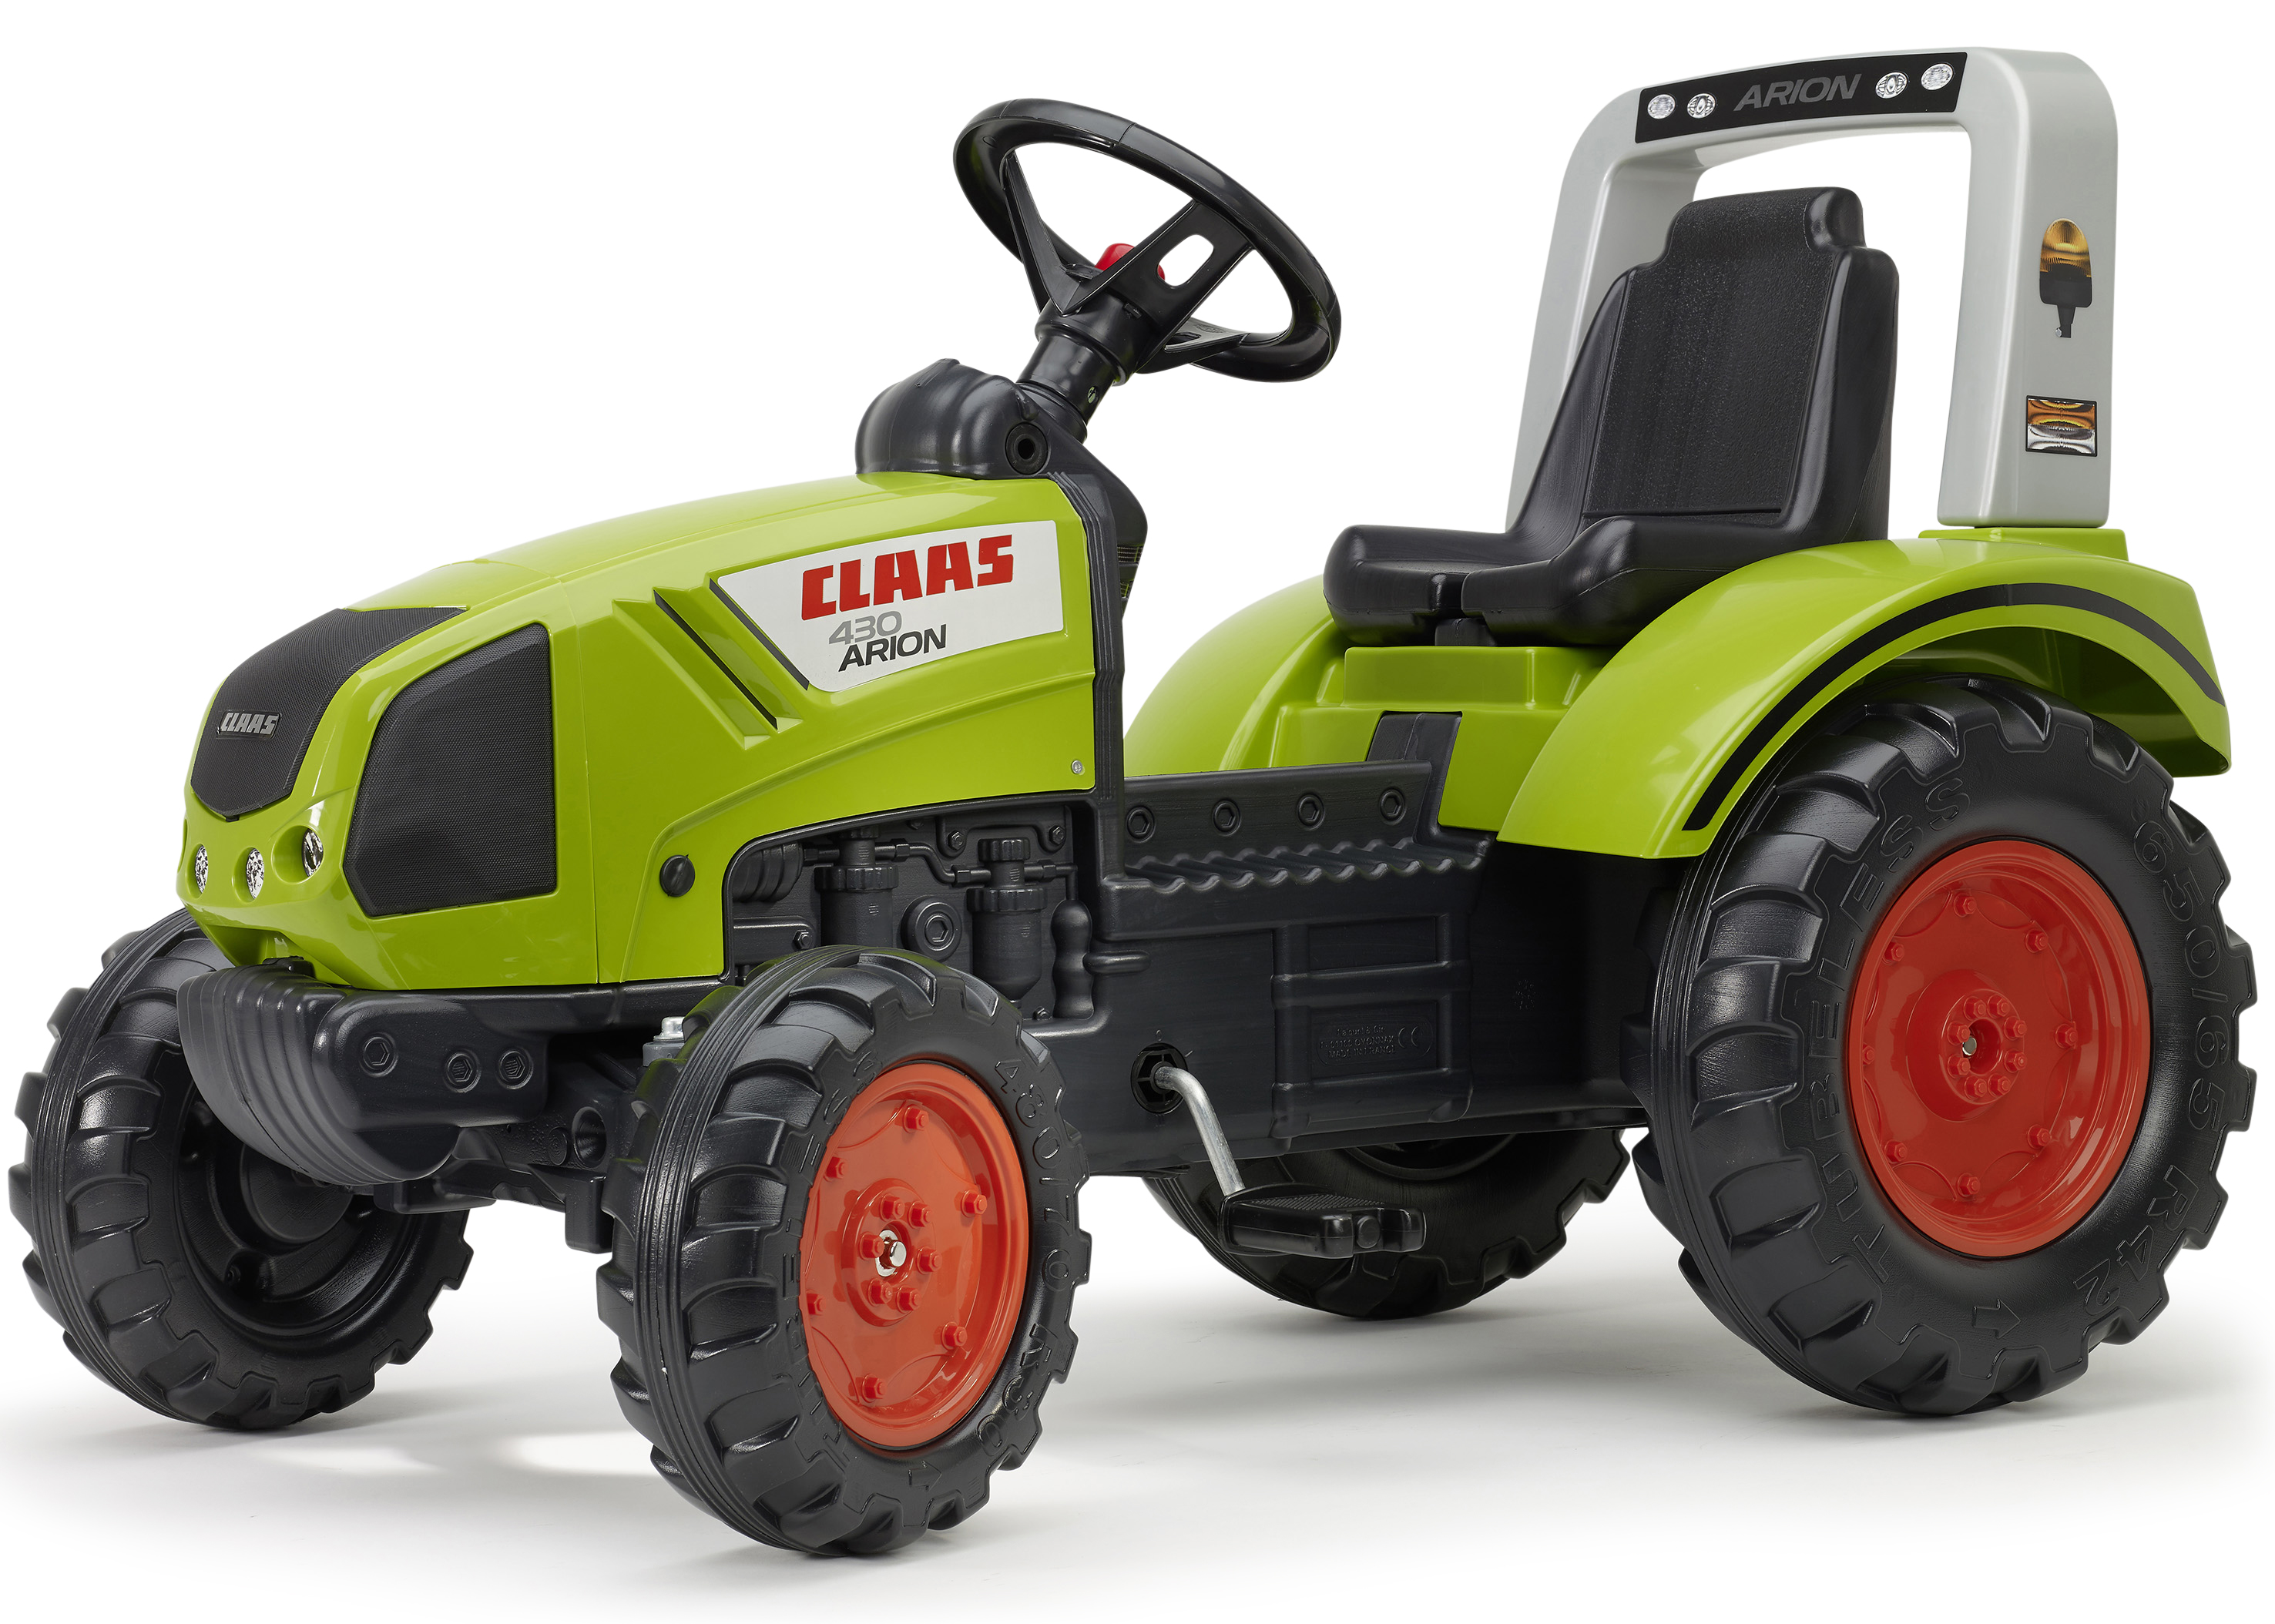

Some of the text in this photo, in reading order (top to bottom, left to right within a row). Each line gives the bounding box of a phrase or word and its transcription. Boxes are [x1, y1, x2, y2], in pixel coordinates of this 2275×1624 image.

[1733, 74, 1862, 111] ARION
[801, 534, 1014, 621] CLAAS
[828, 610, 902, 645] 430
[838, 623, 947, 672] ARION
[220, 712, 279, 735] CLAAS
[1807, 777, 1971, 1284] TUBELESS
[2072, 820, 2232, 1315] 650/65 R42
